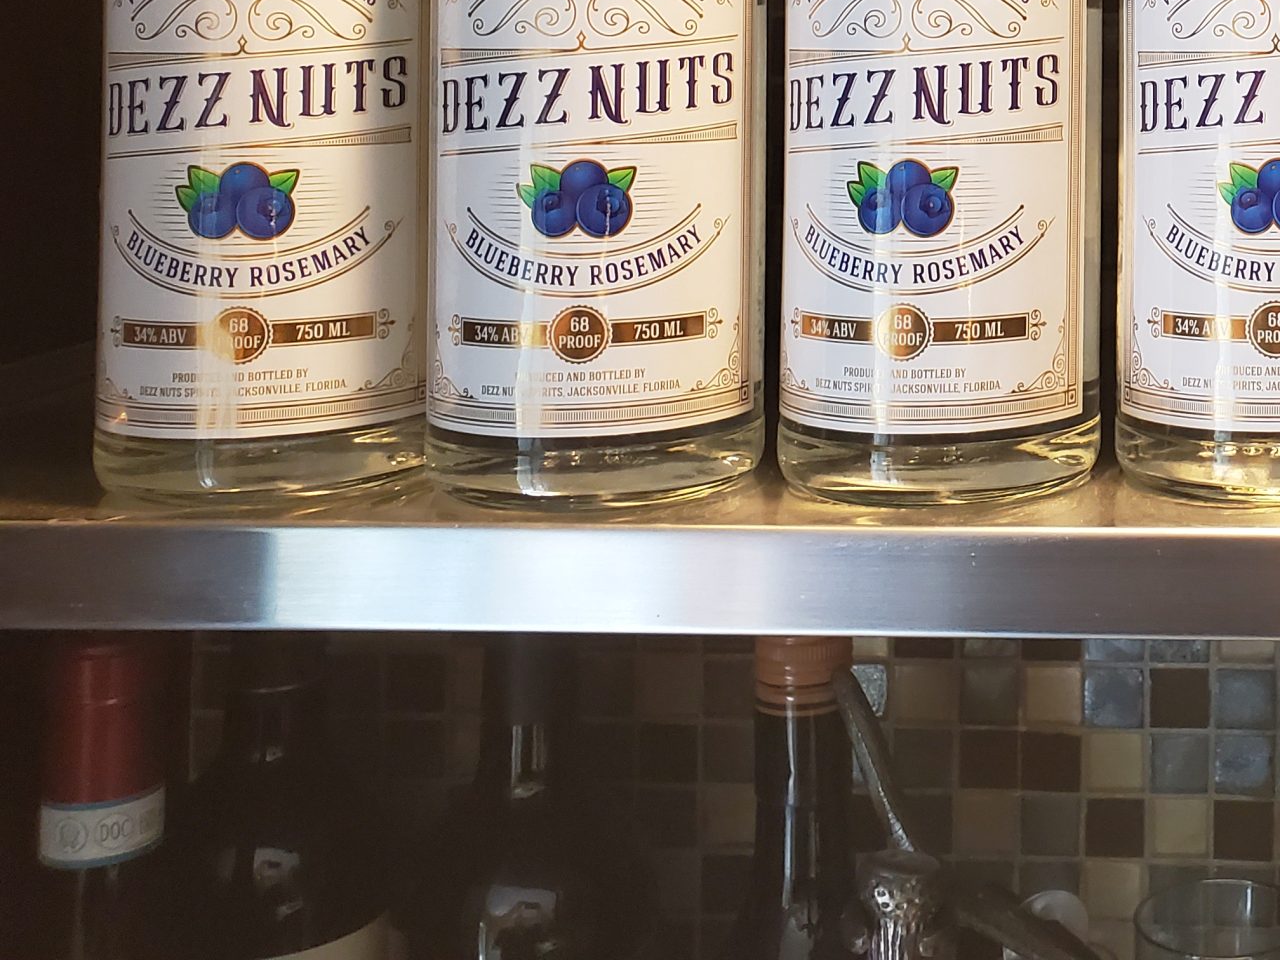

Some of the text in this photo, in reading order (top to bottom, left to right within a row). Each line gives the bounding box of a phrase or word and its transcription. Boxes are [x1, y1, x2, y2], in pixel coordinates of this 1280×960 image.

[109, 56, 408, 136] DEZZ NUTS
[442, 52, 734, 133] DEZZ NUTS
[790, 54, 1060, 131] DEZZ NUTS
[1140, 69, 1266, 132] DEZZ
[127, 226, 371, 288] BLUEBERRY ROSEMARY
[466, 224, 701, 286] BLUEBERRY ROSEMARY
[805, 224, 1025, 284] BLUEBERRY ROSEMARY
[1166, 223, 1276, 282] BLUEBERRY
[229, 317, 249, 332] 68
[570, 316, 589, 332] 68
[810, 319, 857, 338] 34% ABV
[894, 314, 911, 330] 68
[955, 320, 1005, 339] 750 ML
[1175, 318, 1199, 335] 34%
[133, 326, 187, 344] 34% ABV
[295, 322, 350, 340] 750 ML
[475, 325, 498, 342] 34%
[634, 322, 683, 340] 750 ML
[220, 334, 261, 350] OOF
[559, 334, 601, 349] PROOF
[248, 369, 294, 382] BOTTLED
[296, 368, 308, 378] BY
[566, 371, 586, 382] AND
[589, 369, 632, 381] BOTTLED
[634, 368, 646, 378] BY
[911, 368, 952, 379] BOTTLED
[955, 368, 966, 378] BY
[1182, 376, 1202, 388] DEZZ
[160, 387, 181, 397] NUTS
[305, 380, 346, 392] FLORIDA
[481, 385, 500, 396] DEZZ
[642, 379, 681, 392] FLORIDA
[832, 380, 852, 391] NUTS
[963, 380, 1001, 391] FLORIDA
